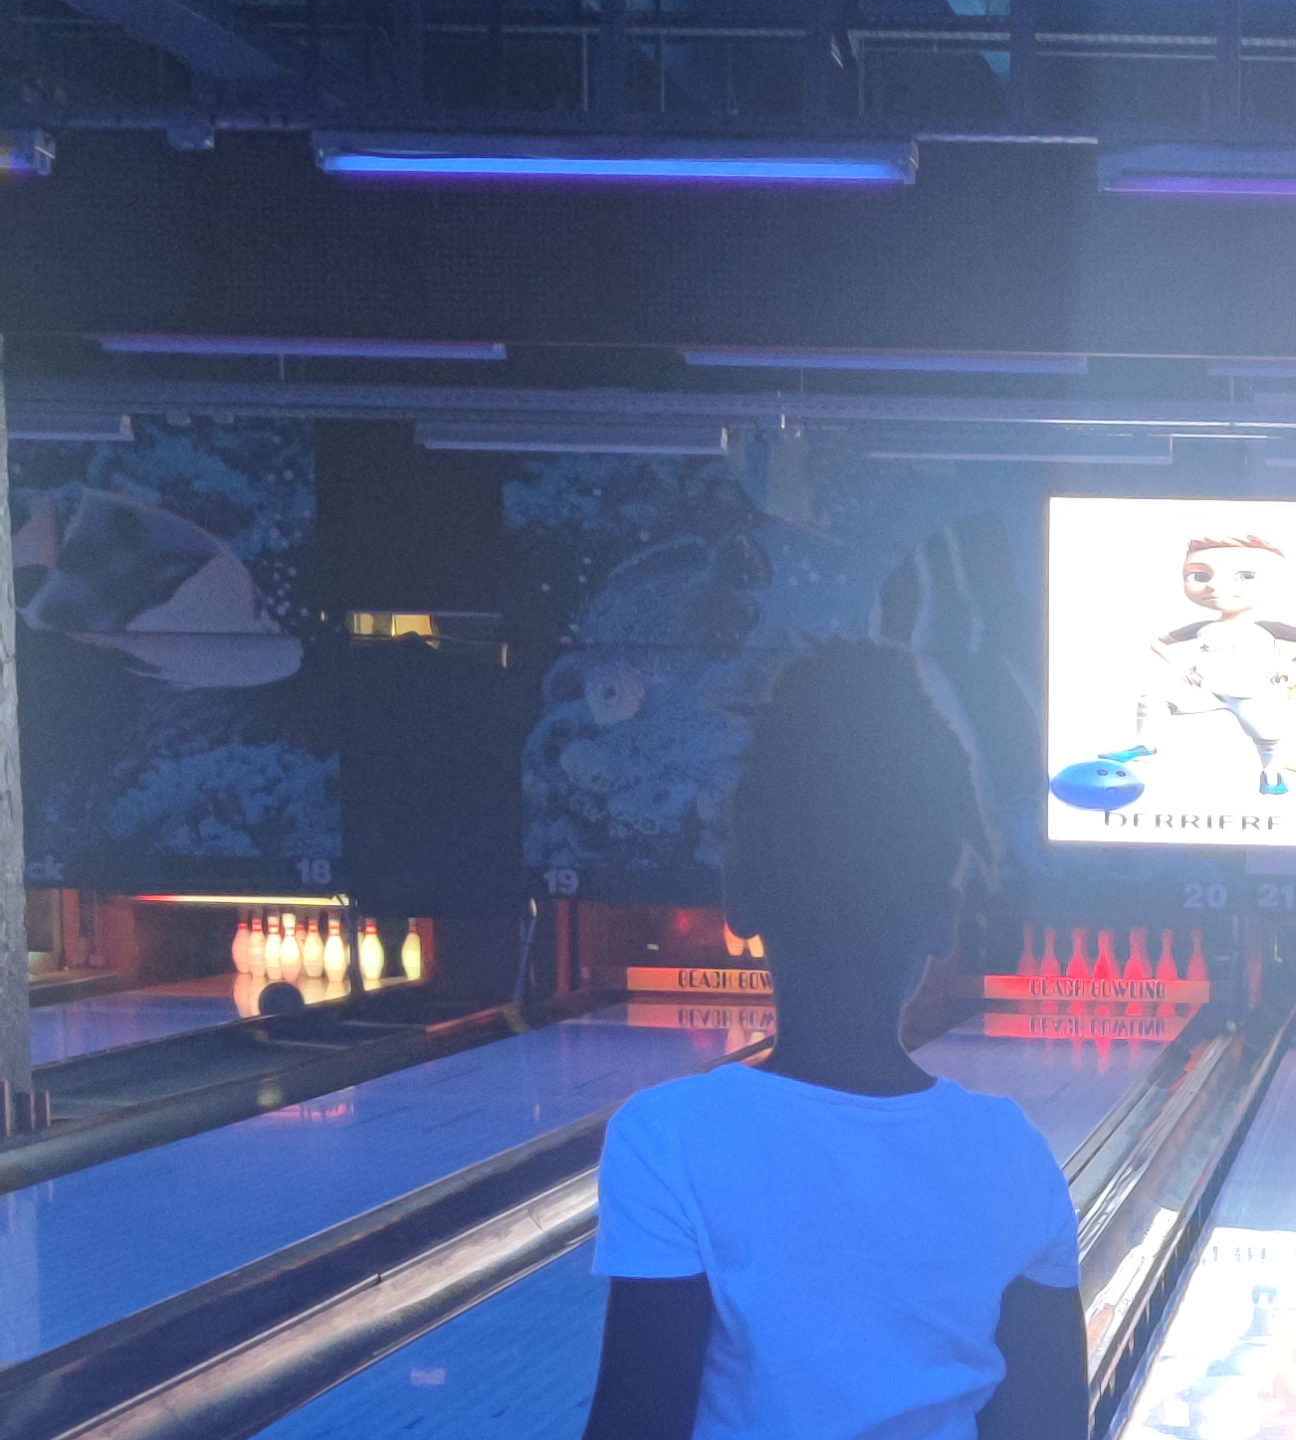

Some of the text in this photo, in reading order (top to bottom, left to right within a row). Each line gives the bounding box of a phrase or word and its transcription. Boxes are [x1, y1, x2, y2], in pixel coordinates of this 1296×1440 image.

[296, 858, 332, 885] 18
[543, 868, 579, 895] 19
[1184, 882, 1228, 910] 20
[1256, 882, 1295, 910] 21
[678, 970, 732, 989] BEACH
